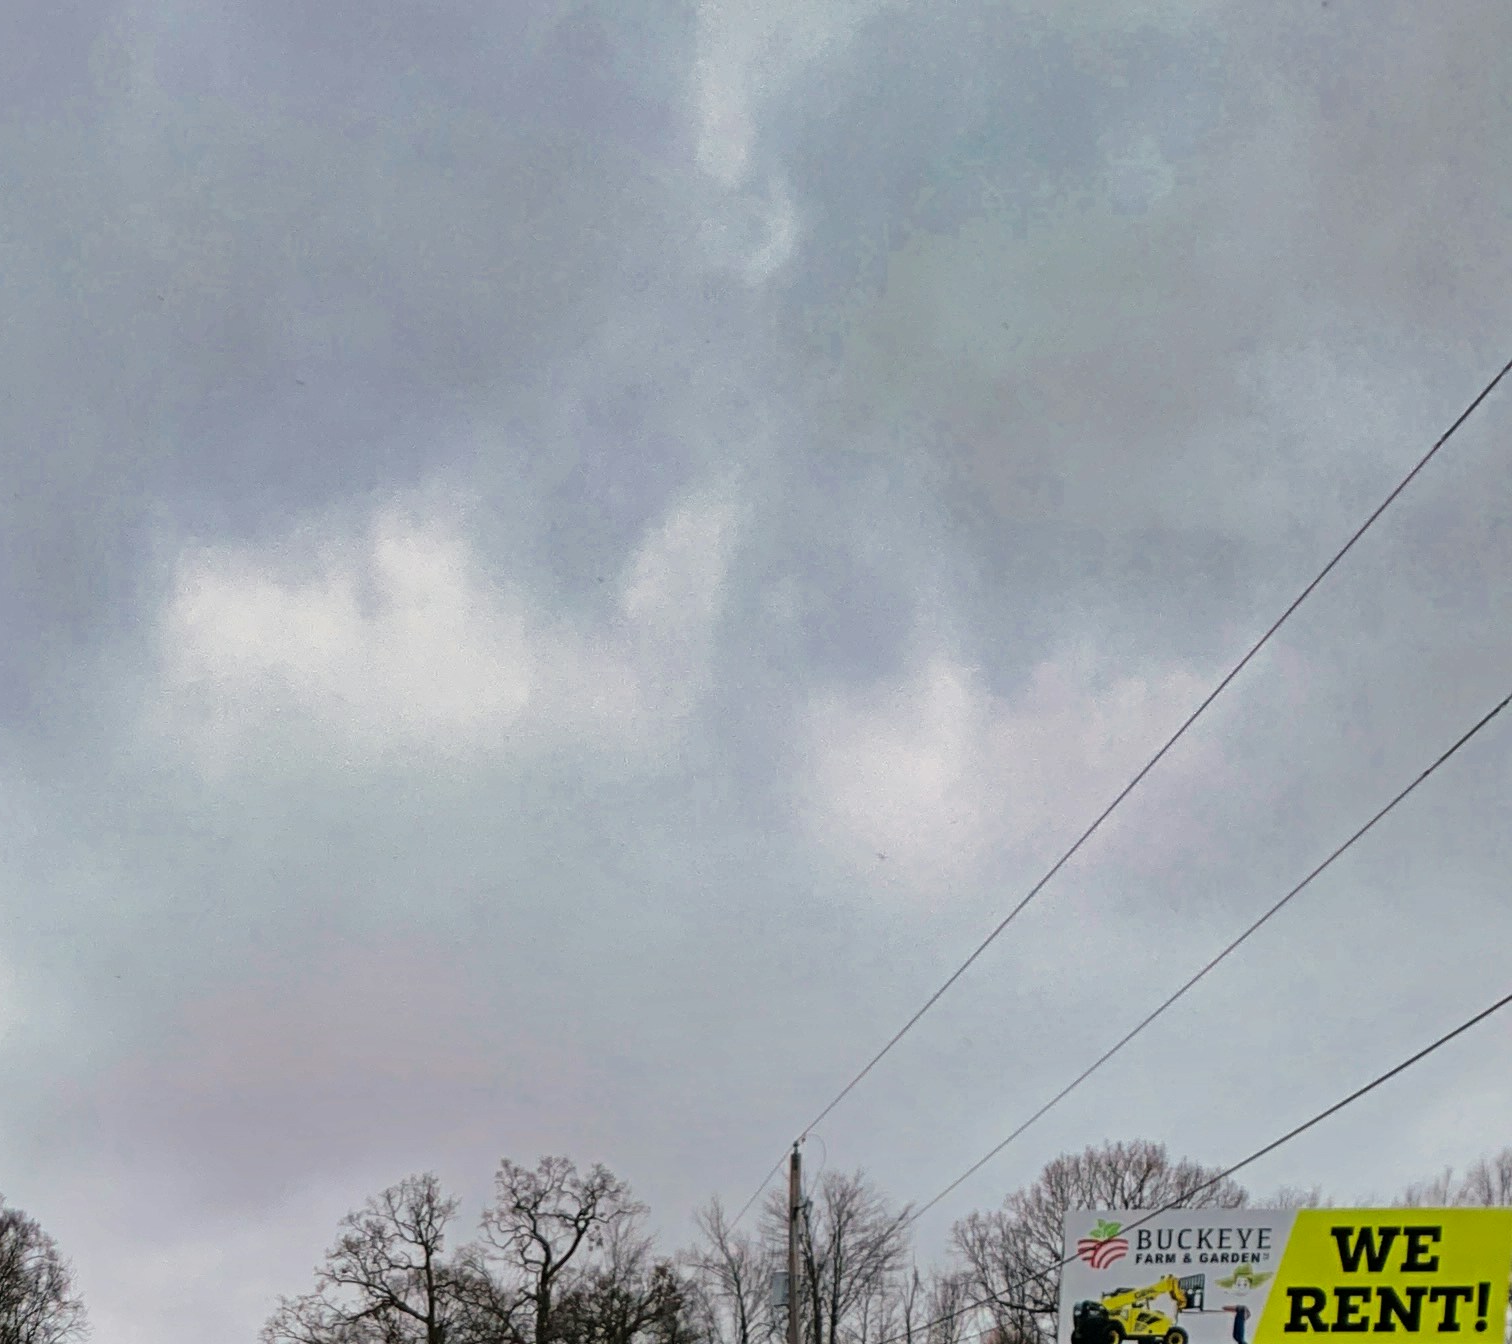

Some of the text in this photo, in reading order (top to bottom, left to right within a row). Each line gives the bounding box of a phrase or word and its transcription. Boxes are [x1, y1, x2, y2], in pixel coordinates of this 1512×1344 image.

[1137, 1228, 1272, 1250] BUCKEYE
[1330, 1225, 1443, 1273] WE
[1136, 1253, 1176, 1263] FARM
[1183, 1253, 1192, 1263] &
[1199, 1252, 1261, 1263] GARDEN
[1284, 1282, 1491, 1333] RENT!
